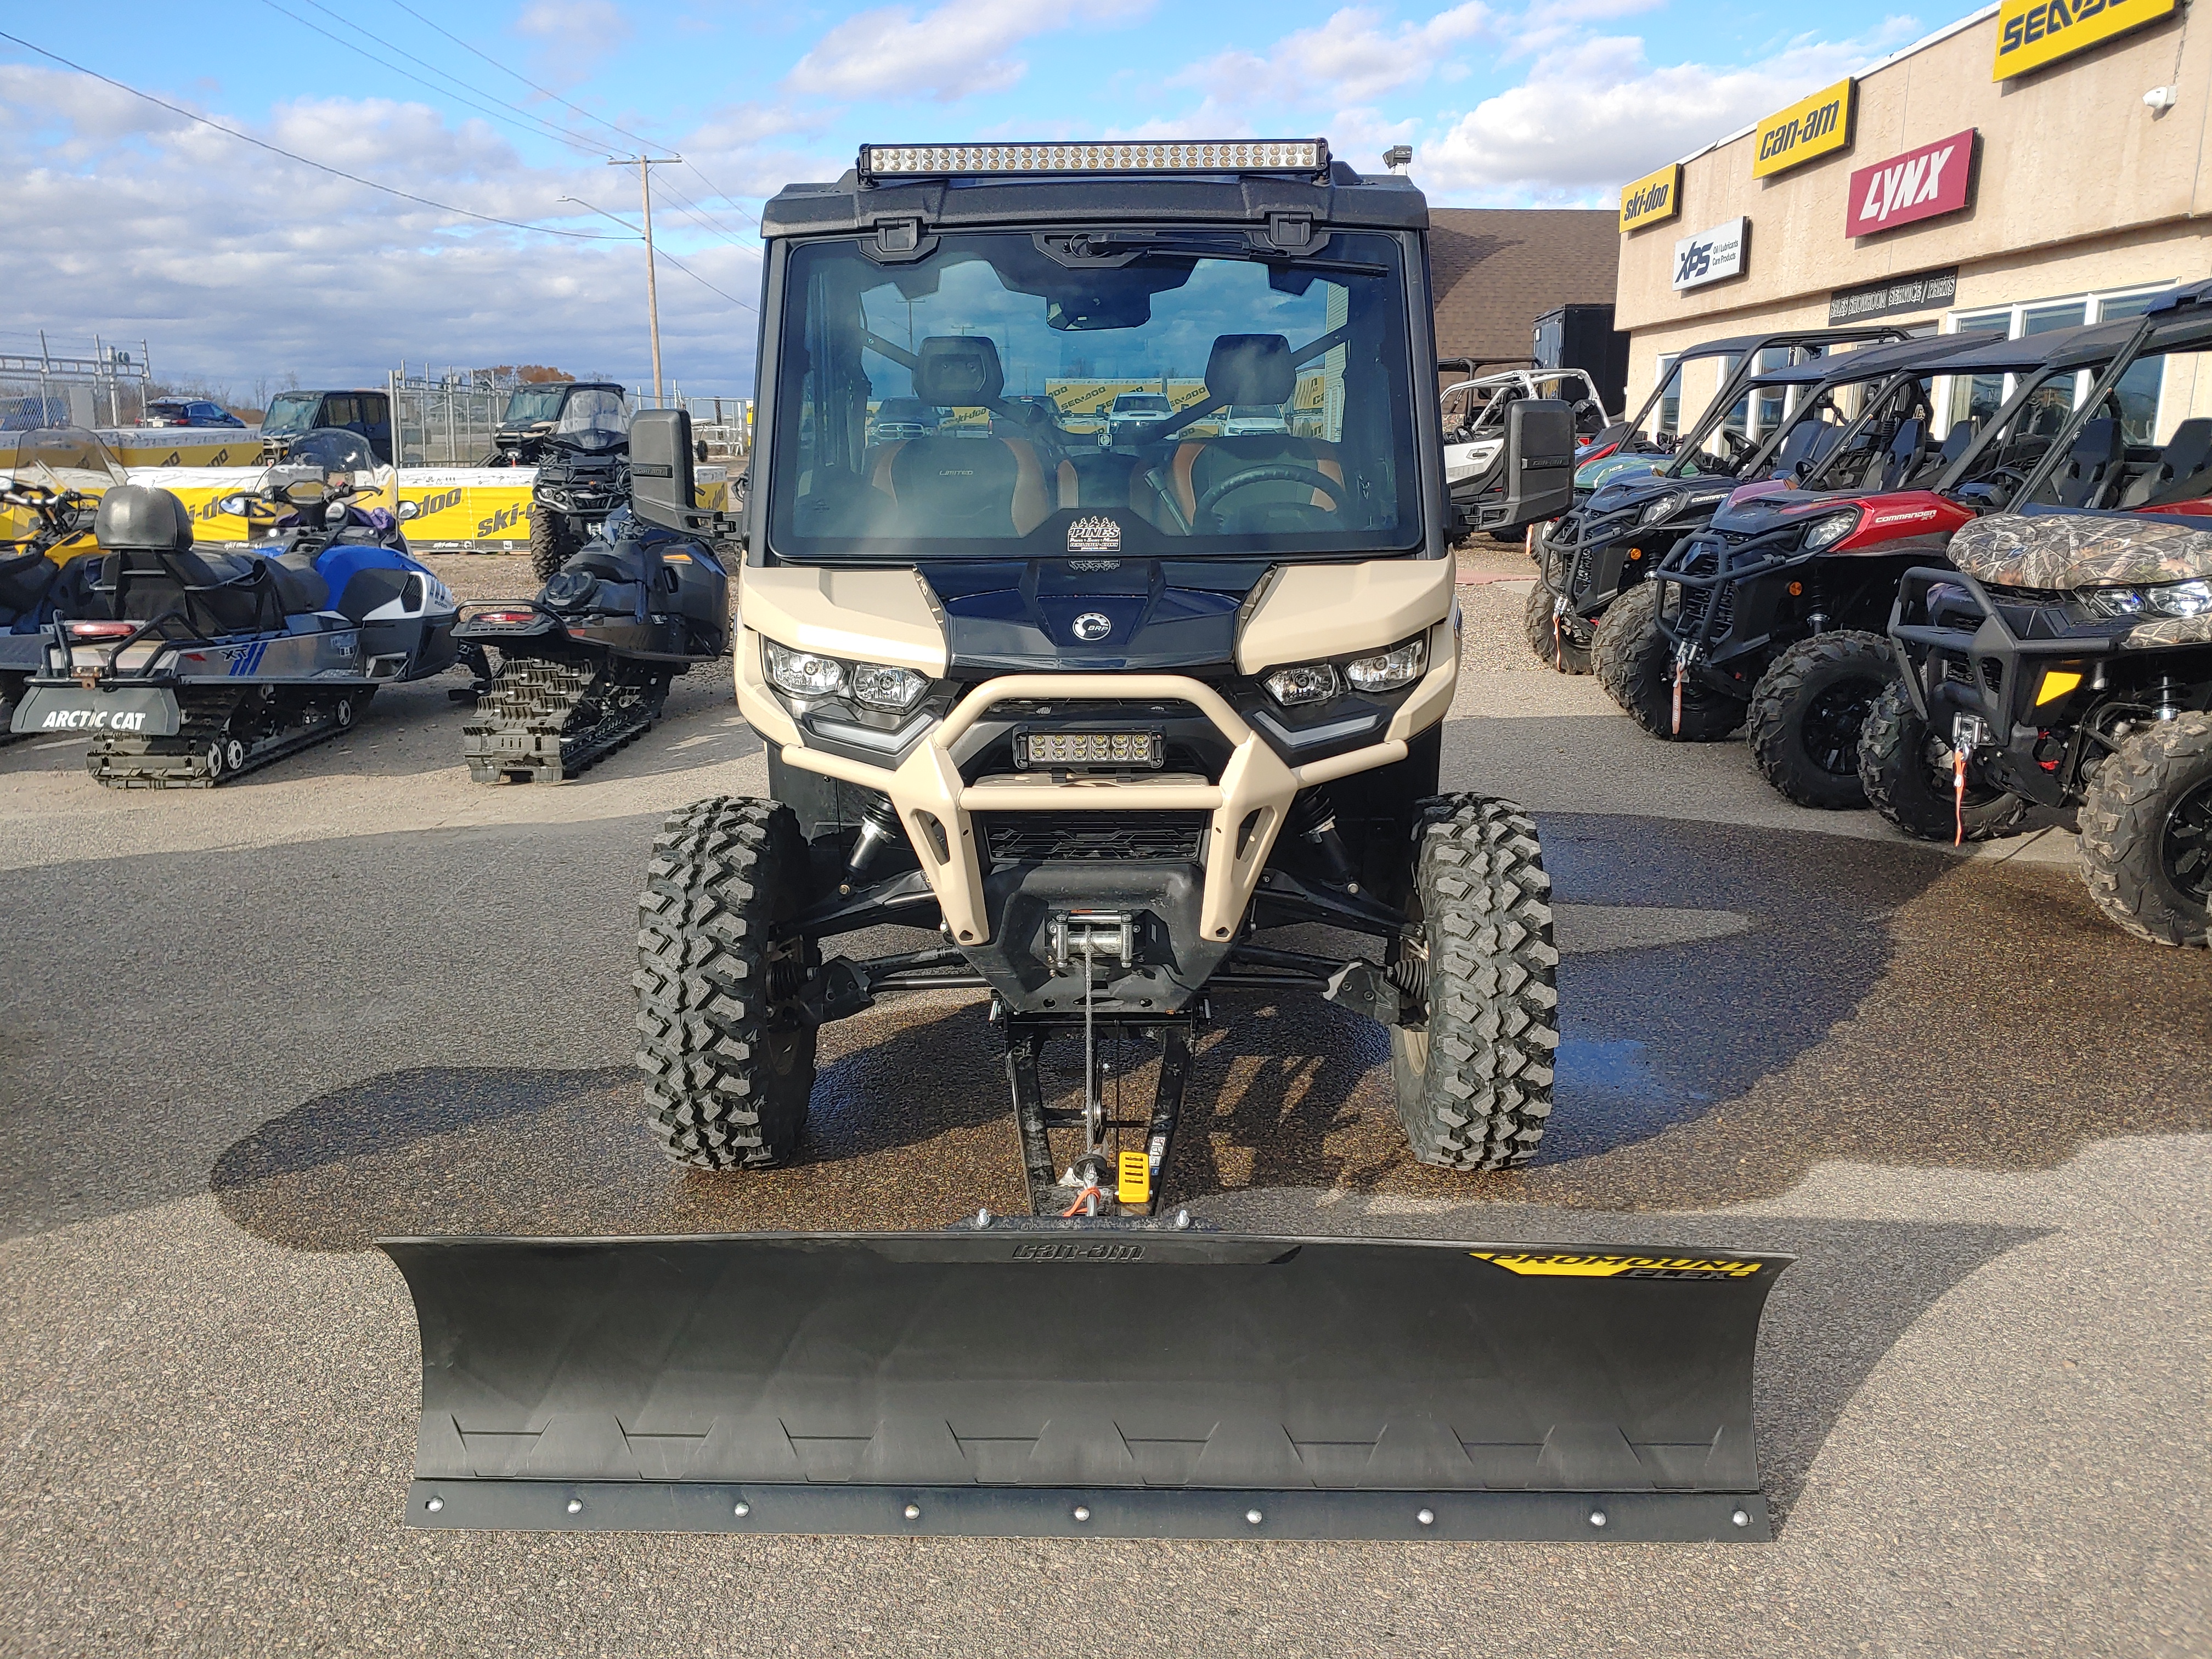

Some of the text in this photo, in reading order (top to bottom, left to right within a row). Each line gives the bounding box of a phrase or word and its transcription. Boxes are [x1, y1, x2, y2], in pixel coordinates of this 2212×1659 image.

[1759, 100, 1839, 161] can-am
[1859, 145, 1955, 222] LYNX
[1624, 183, 1669, 221] ski-doo
[1675, 241, 1714, 284] XPS
[1720, 252, 1736, 264] Products
[1830, 296, 1848, 318] SALES
[1848, 289, 1888, 316] SHOWROOM
[1888, 280, 1922, 307] SERVICE
[1927, 275, 1955, 299] PARTS
[1691, 493, 1729, 503] COMMAND
[1875, 510, 1937, 523] COMMANDER
[1070, 528, 1120, 538] PINES
[221, 649, 247, 661] XT
[41, 710, 146, 730] ARCTIC CAT
[1013, 1244, 1146, 1261] can-am
[1486, 1254, 1760, 1271] PROMOUNT
